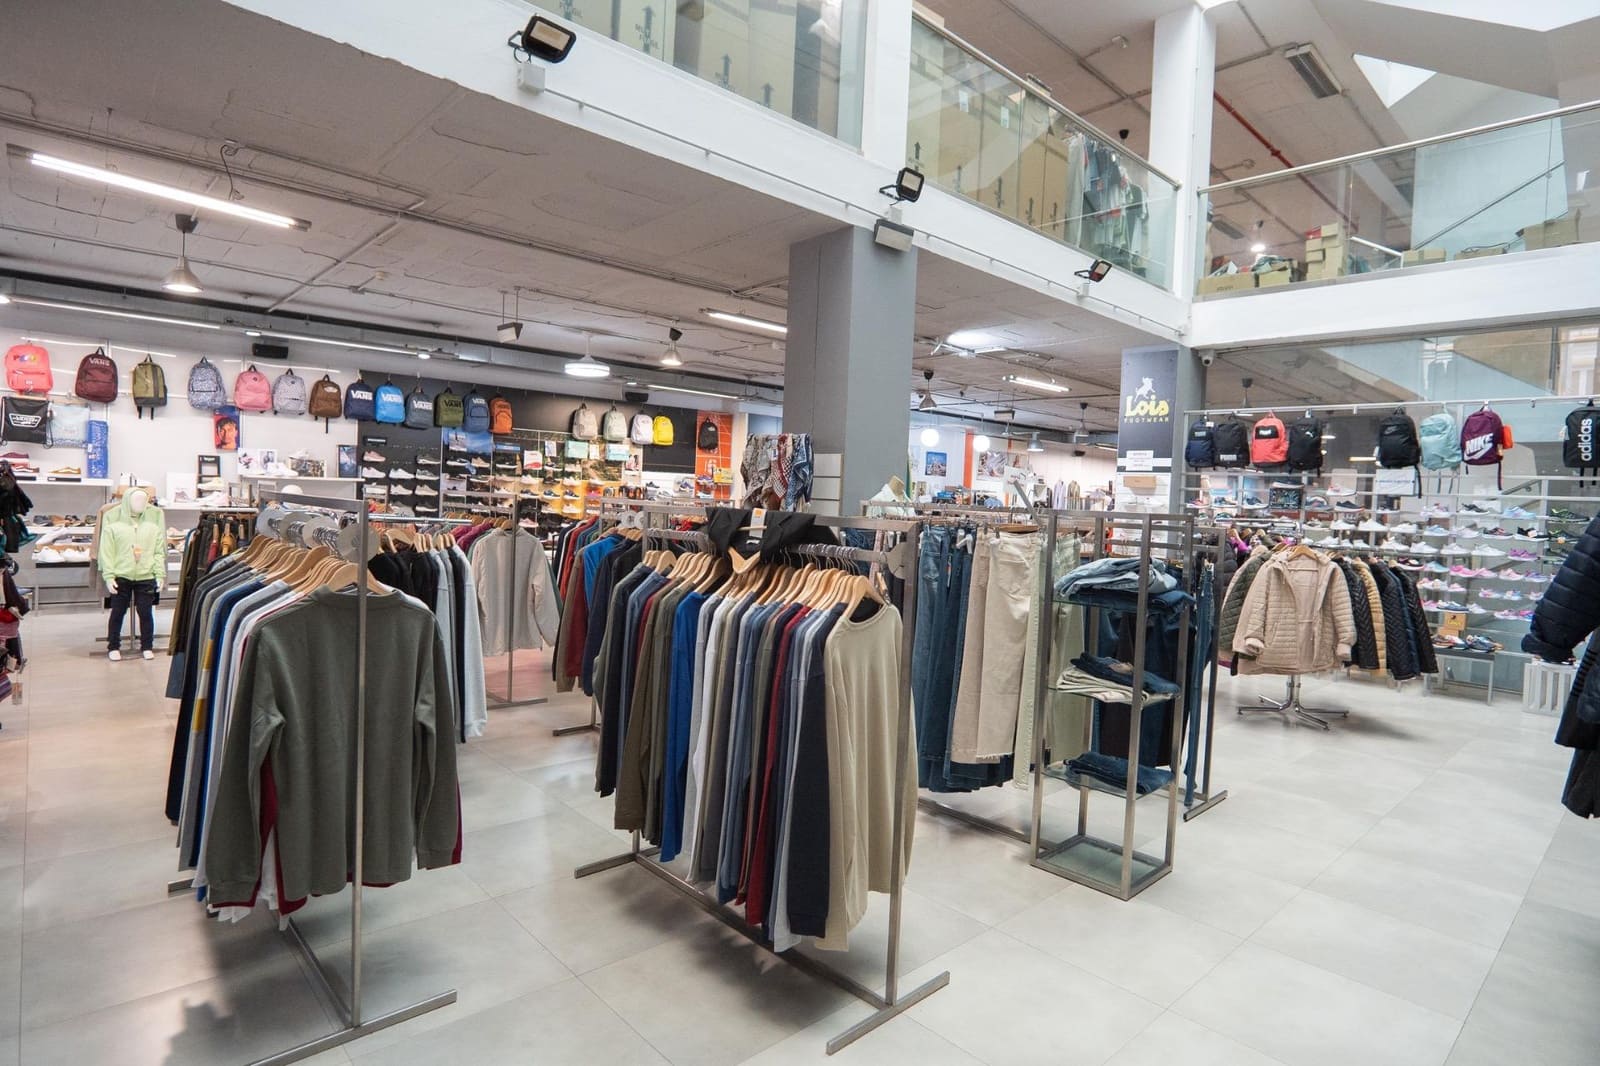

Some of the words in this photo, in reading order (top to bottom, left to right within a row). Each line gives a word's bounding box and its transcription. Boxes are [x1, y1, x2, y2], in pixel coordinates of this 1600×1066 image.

[89, 357, 110, 367] VANS
[351, 390, 373, 401] VANS
[412, 400, 433, 411] VANS
[1125, 395, 1169, 417] Lois
[1465, 433, 1494, 455] NIKE
[1577, 418, 1593, 462] adidas
